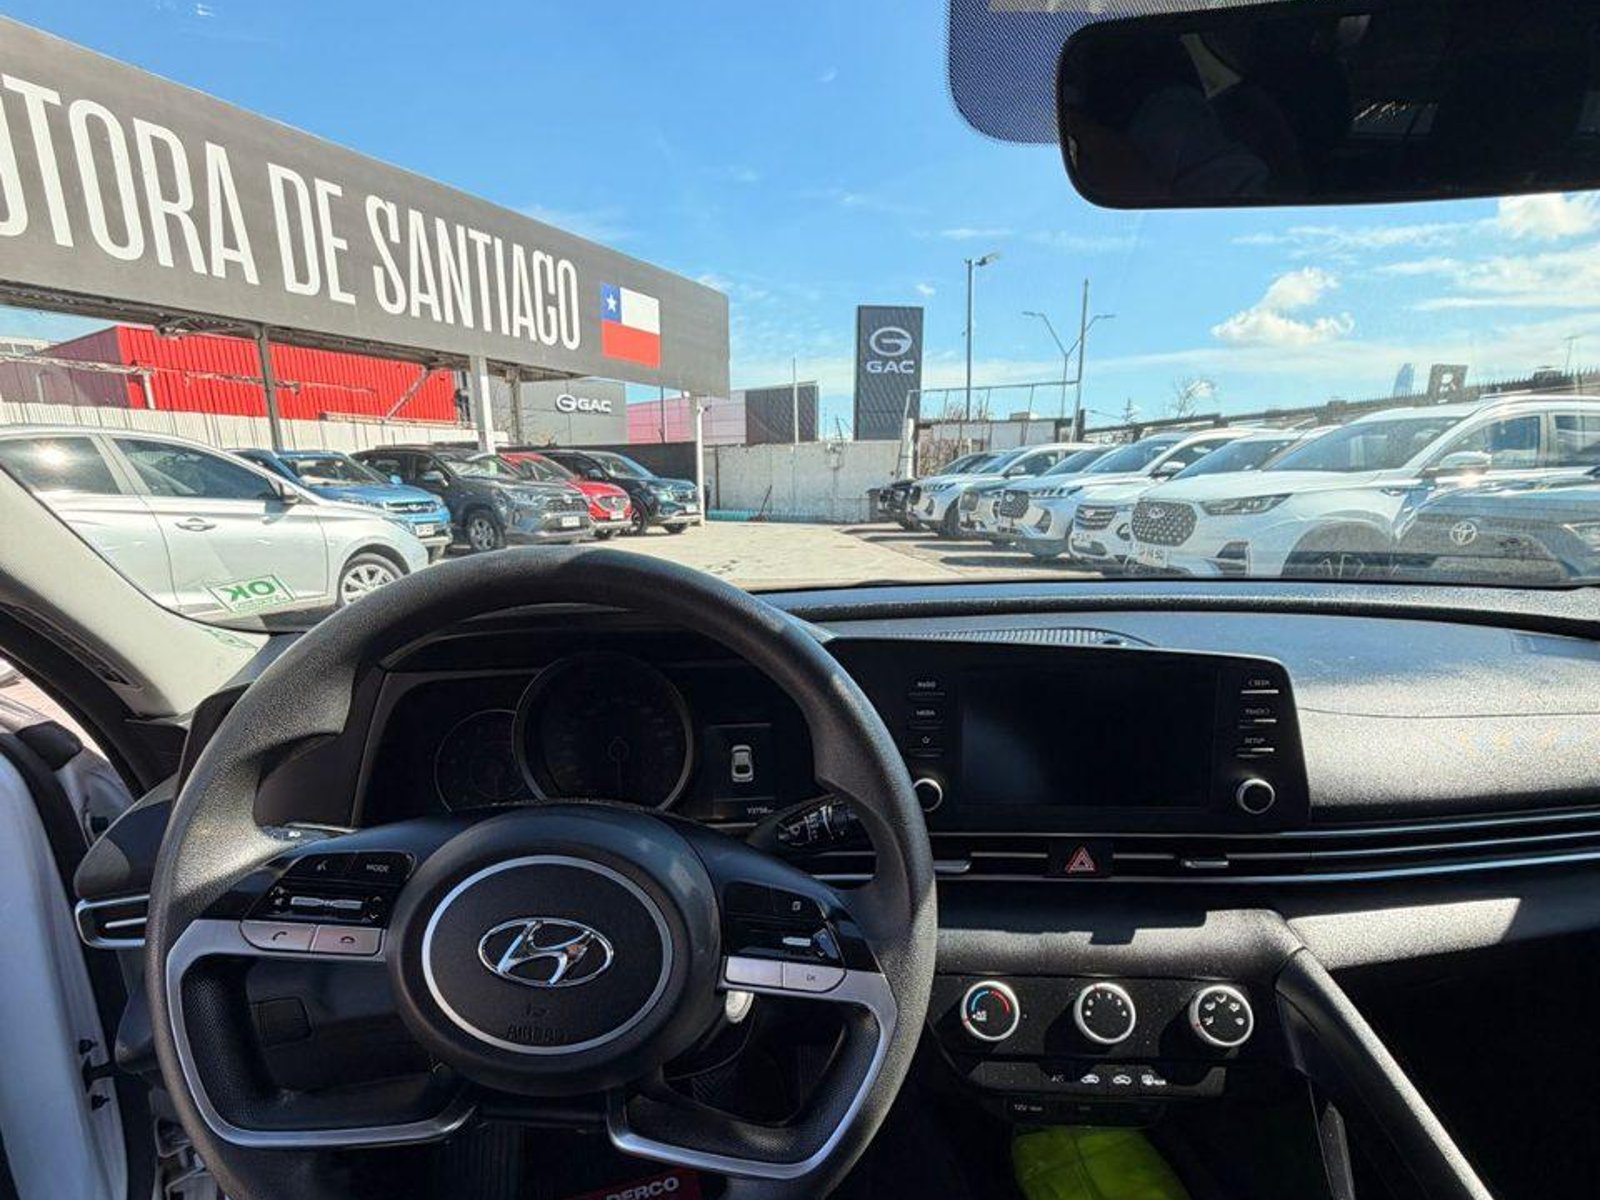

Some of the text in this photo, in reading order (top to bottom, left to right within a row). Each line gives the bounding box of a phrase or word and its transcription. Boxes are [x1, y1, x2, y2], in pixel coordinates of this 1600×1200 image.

[267, 162, 357, 307] DE
[365, 194, 582, 350] SANTIAGO
[866, 360, 915, 374] GAC
[577, 398, 612, 413] GAC
